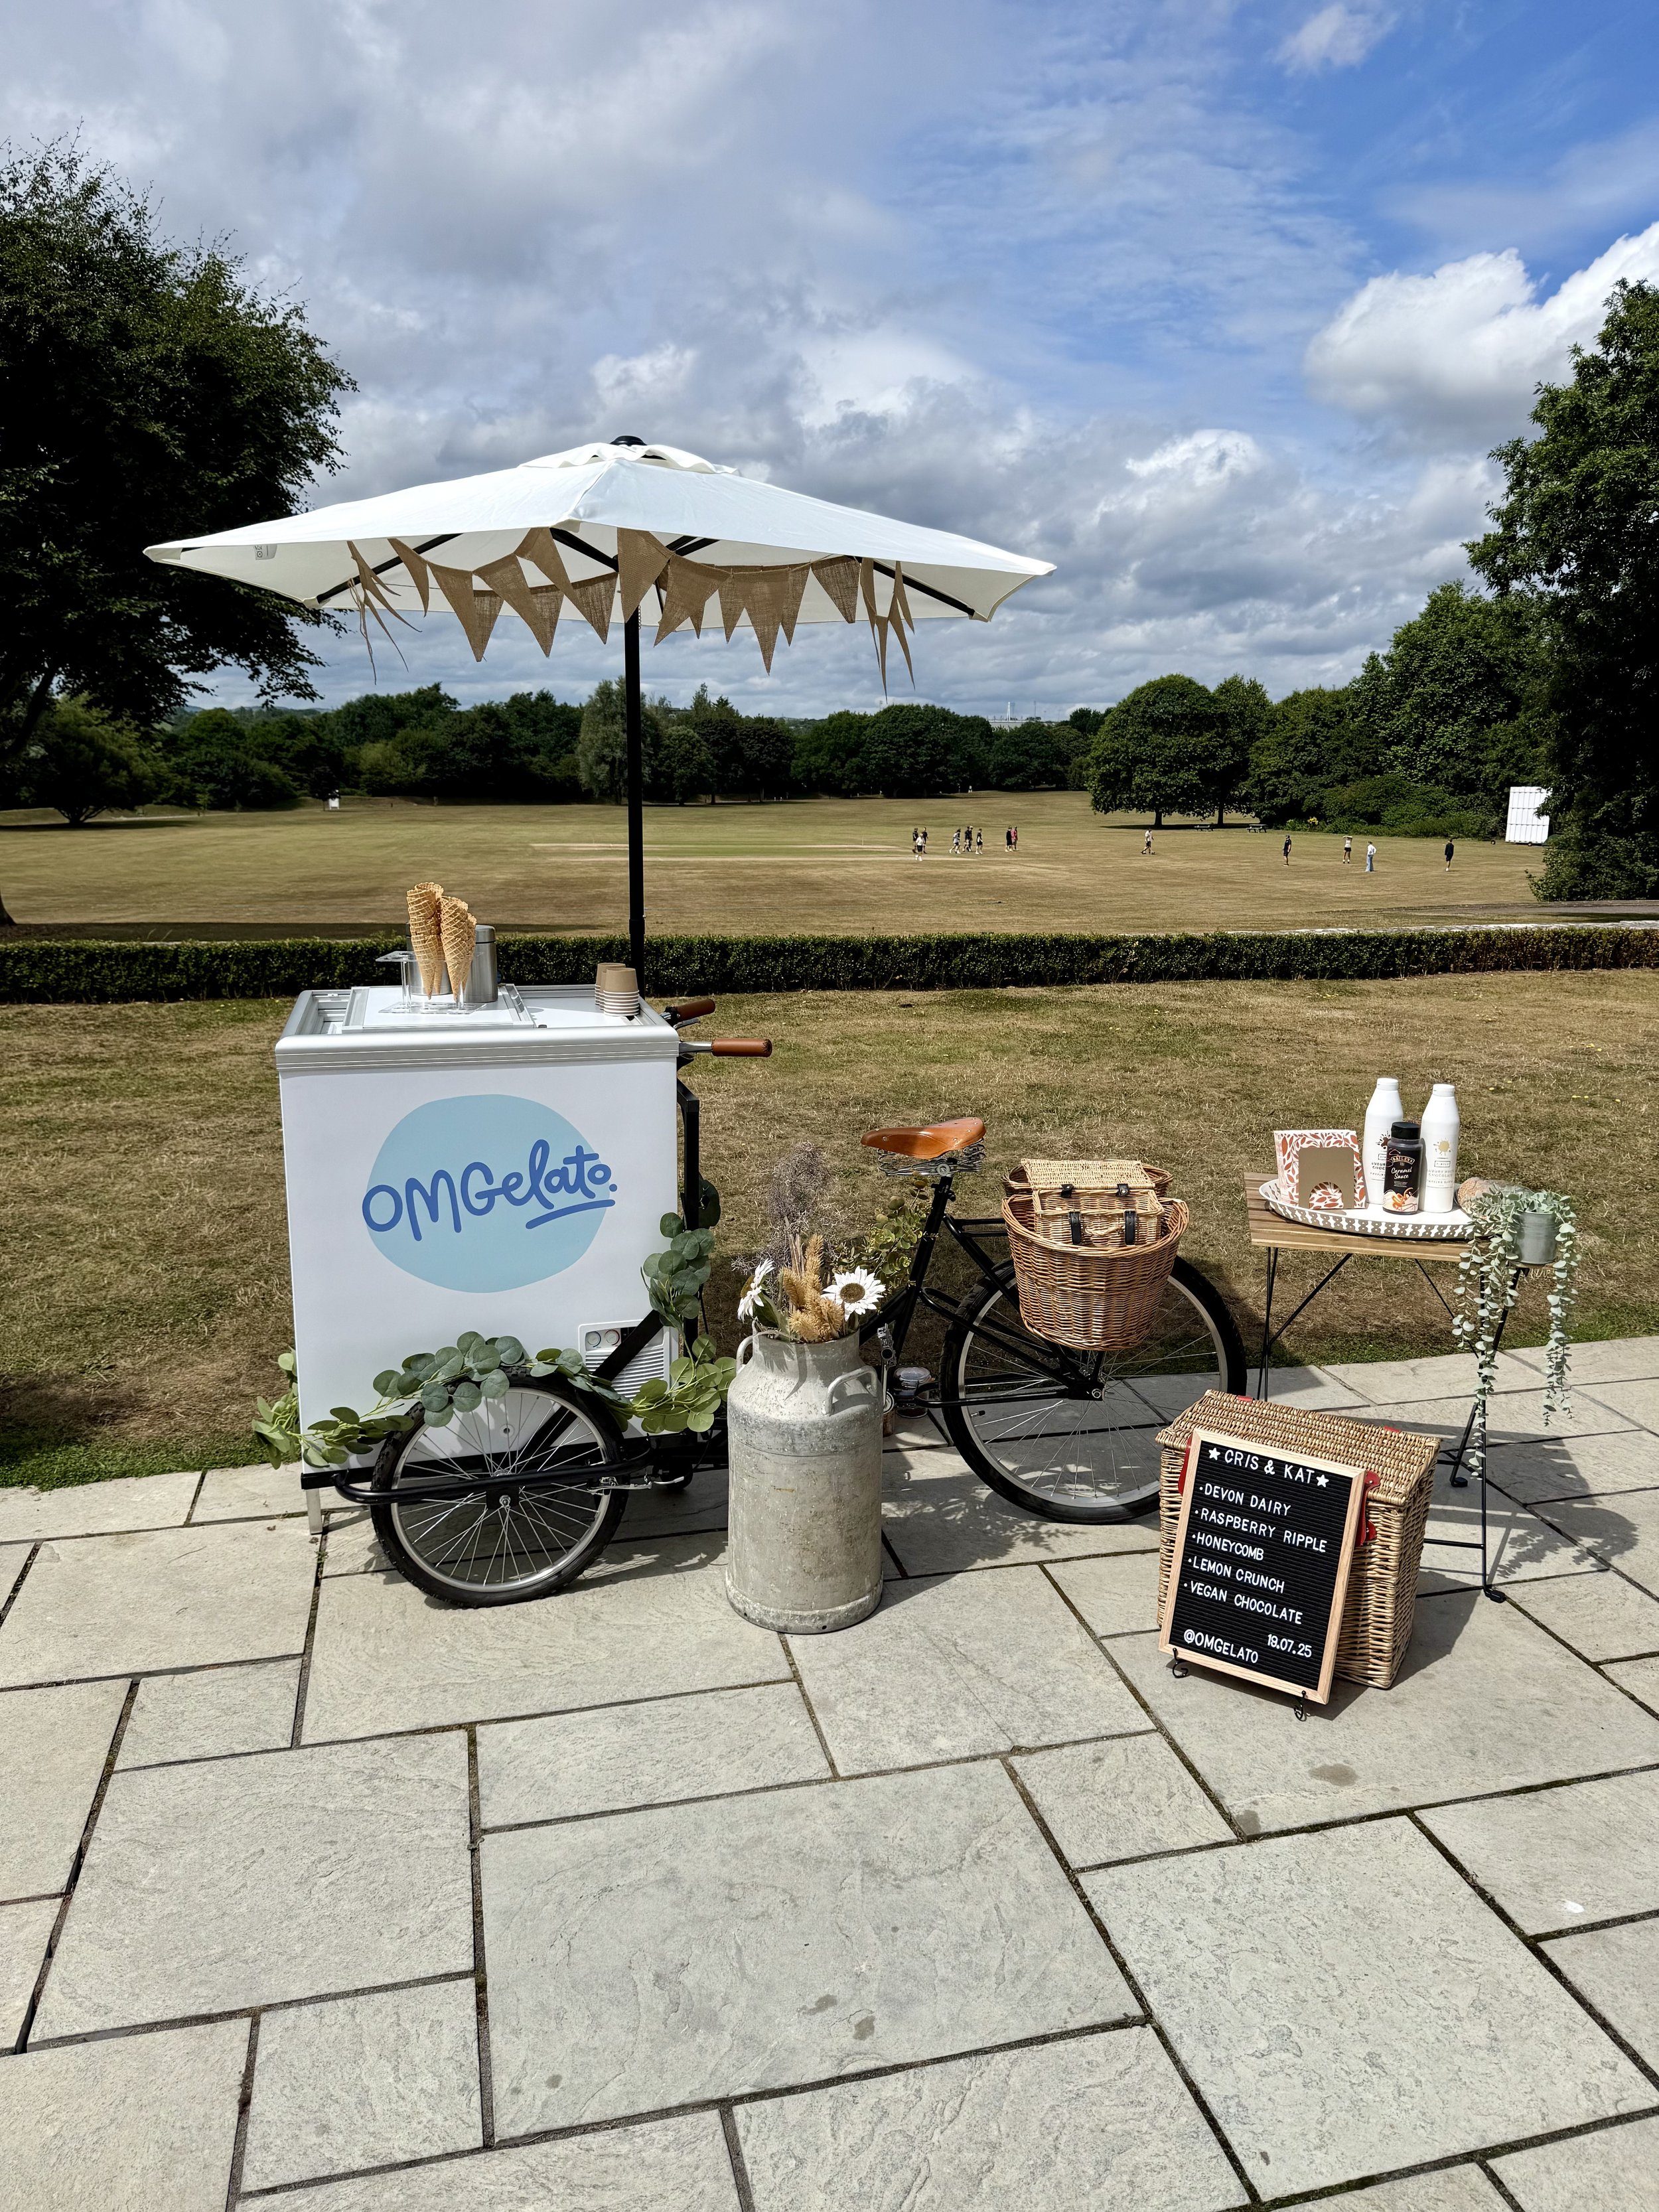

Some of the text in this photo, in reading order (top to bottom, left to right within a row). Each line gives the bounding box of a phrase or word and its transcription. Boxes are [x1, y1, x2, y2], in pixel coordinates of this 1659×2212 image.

[1224, 1449, 1315, 1484] CRIS & KAT
[1204, 1483, 1291, 1516] DEVON DAIRY
[1196, 1531, 1264, 1561] HONEYCOMB
[1200, 1507, 1327, 1553] RASPBERRY RIPPLE
[1192, 1556, 1285, 1594] LEMON CRUNCH
[1190, 1580, 1303, 1625] VEGAN CHOCOLATE
[1183, 1629, 1259, 1664] @OMGELATO
